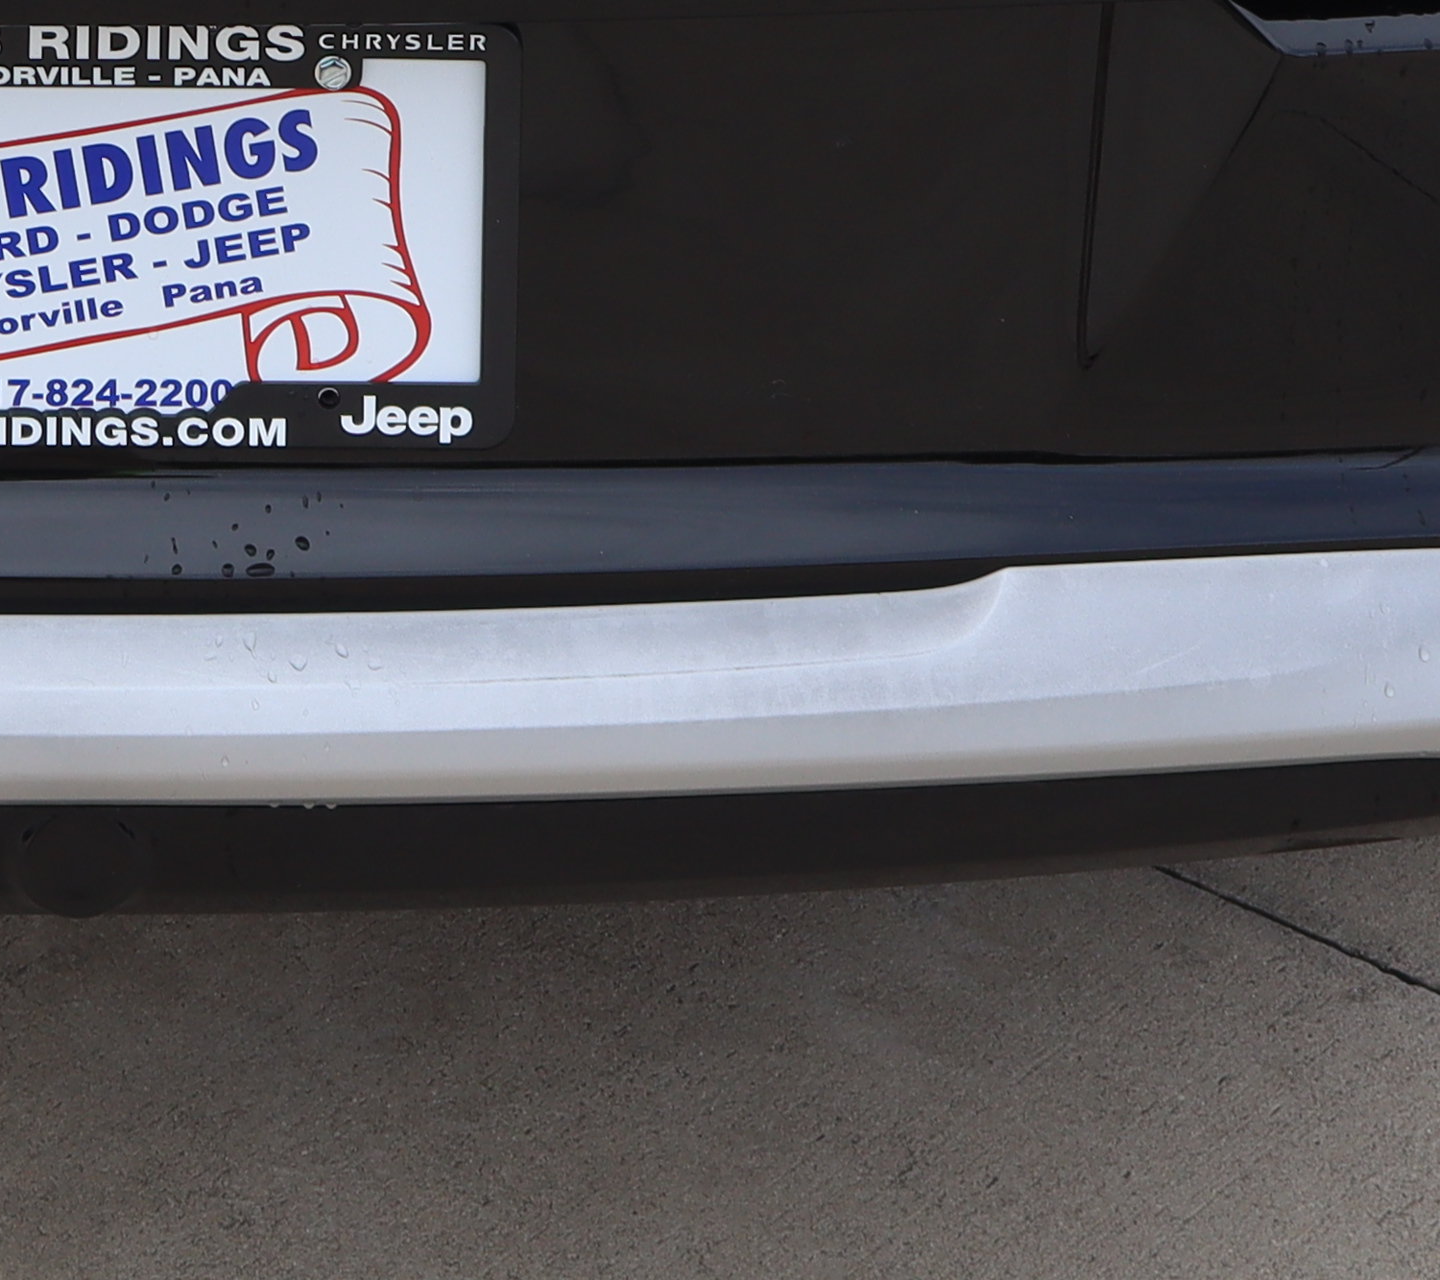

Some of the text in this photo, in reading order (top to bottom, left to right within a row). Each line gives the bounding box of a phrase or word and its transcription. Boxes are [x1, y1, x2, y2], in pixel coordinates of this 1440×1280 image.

[28, 24, 305, 62] RIDINGS
[319, 33, 487, 52] CHRYSLER
[174, 67, 271, 87] PANA
[0, 109, 318, 219] RIDINGS
[107, 186, 289, 242] DODGE
[184, 223, 311, 270] JEEP
[162, 276, 263, 308] Pana
[340, 395, 473, 444] Jeep
